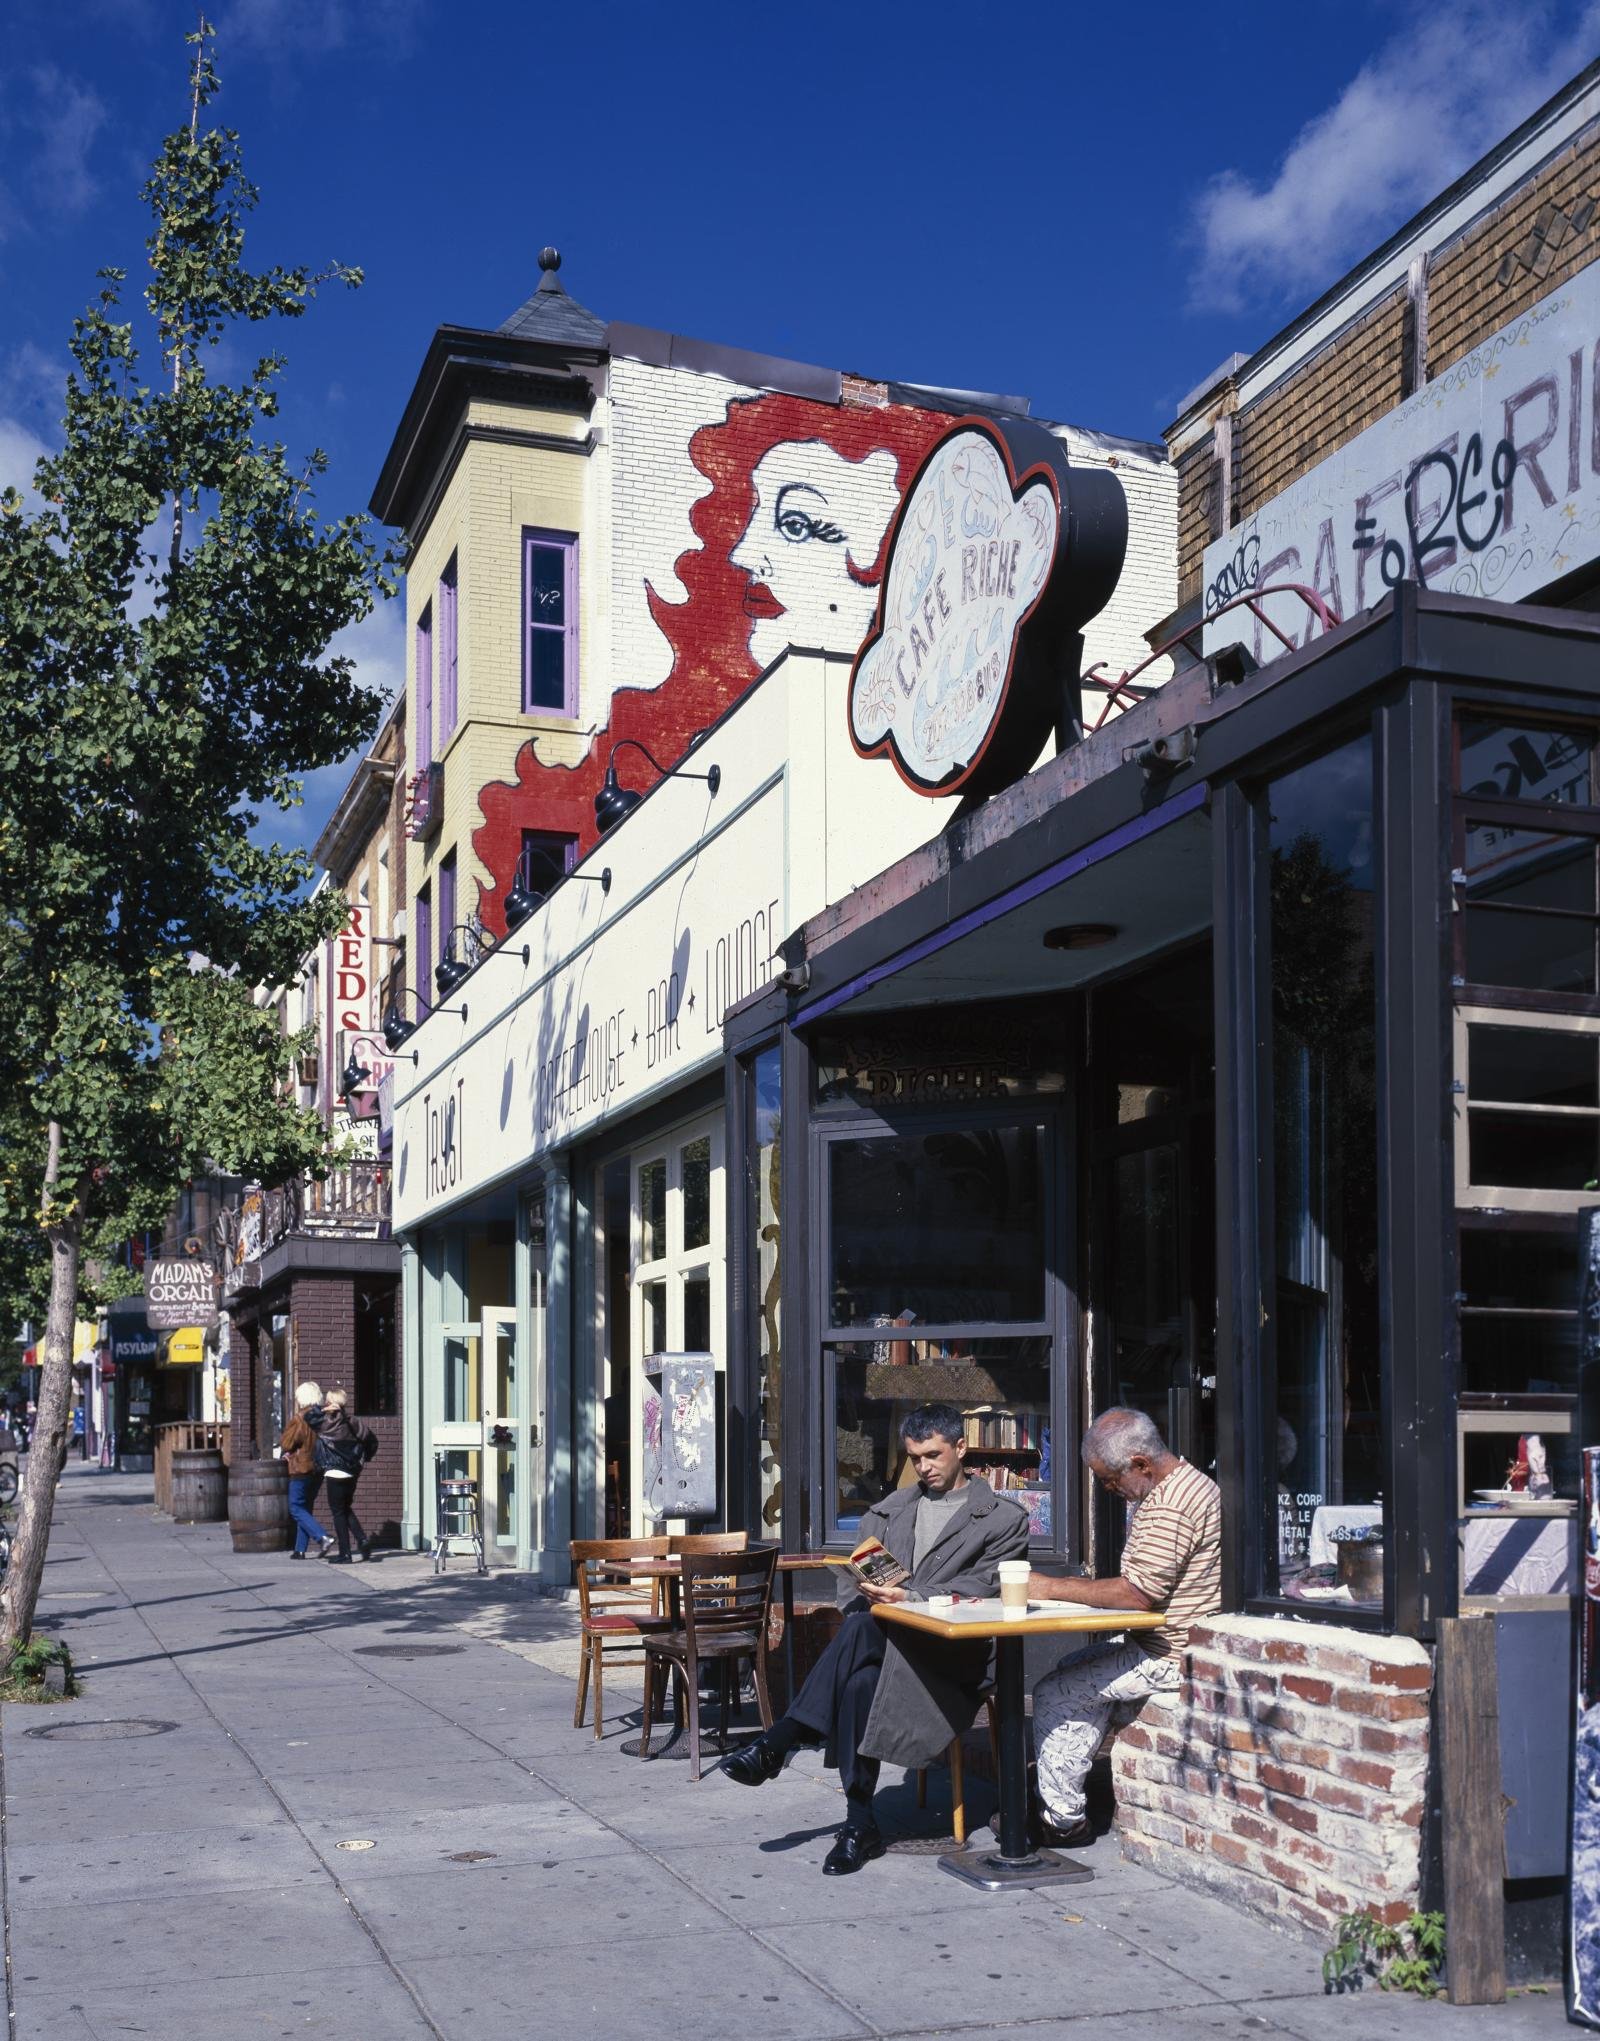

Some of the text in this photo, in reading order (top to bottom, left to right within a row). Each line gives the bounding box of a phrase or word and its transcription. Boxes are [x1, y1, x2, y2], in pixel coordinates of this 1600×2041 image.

[895, 538, 1022, 698] CAFE RICHE
[539, 1008, 625, 1134] COFFEEHOUSE
[646, 972, 681, 1069] BAR
[424, 1078, 465, 1201] TRYST
[149, 1284, 215, 1302] ORGAN
[1278, 1493, 1323, 1506] KZ CORP
